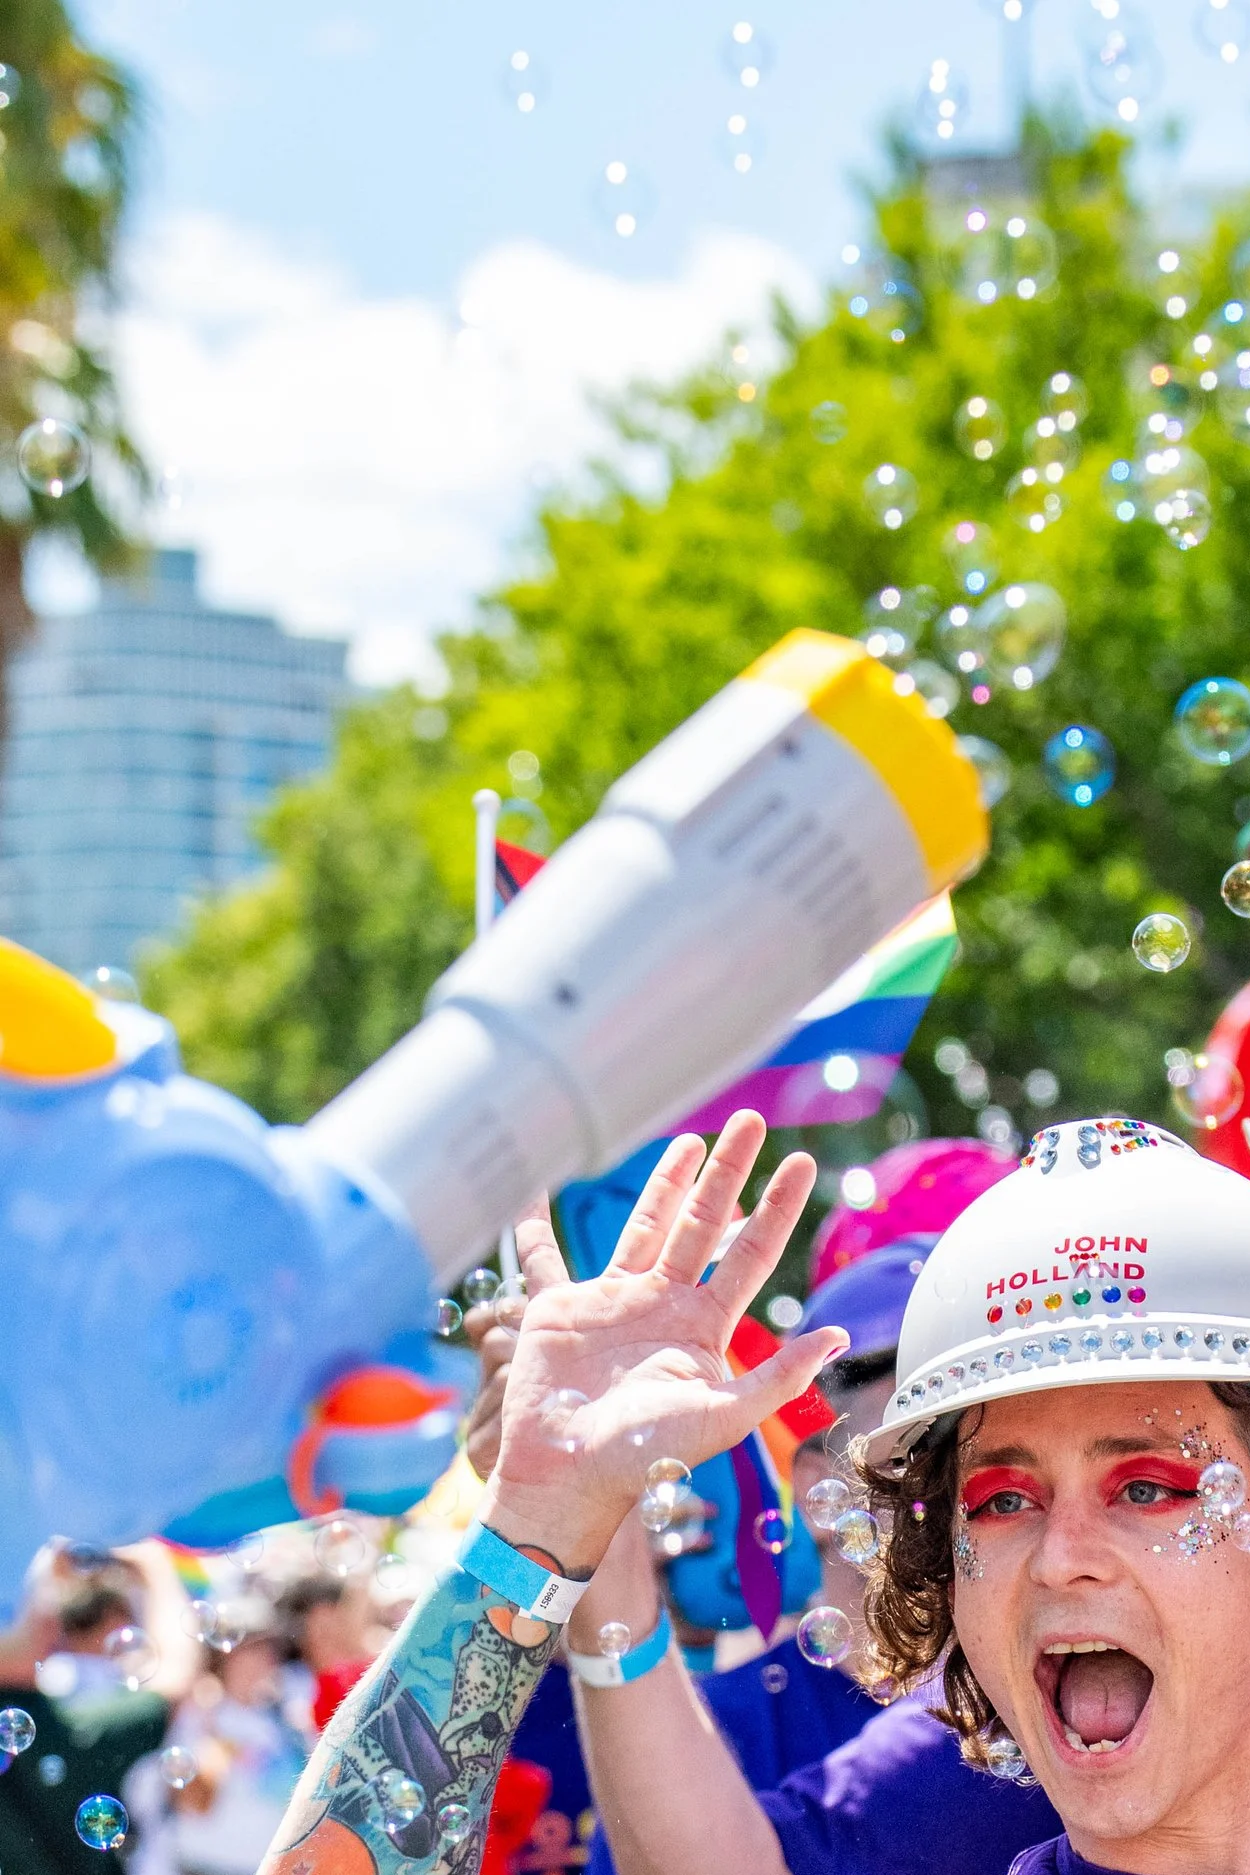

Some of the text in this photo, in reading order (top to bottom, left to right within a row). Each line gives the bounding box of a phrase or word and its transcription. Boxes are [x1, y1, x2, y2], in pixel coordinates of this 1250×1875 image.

[1054, 1236, 1148, 1254] JOHN
[986, 1262, 1145, 1299] HOLLAND
[540, 1583, 560, 1609] 158933
